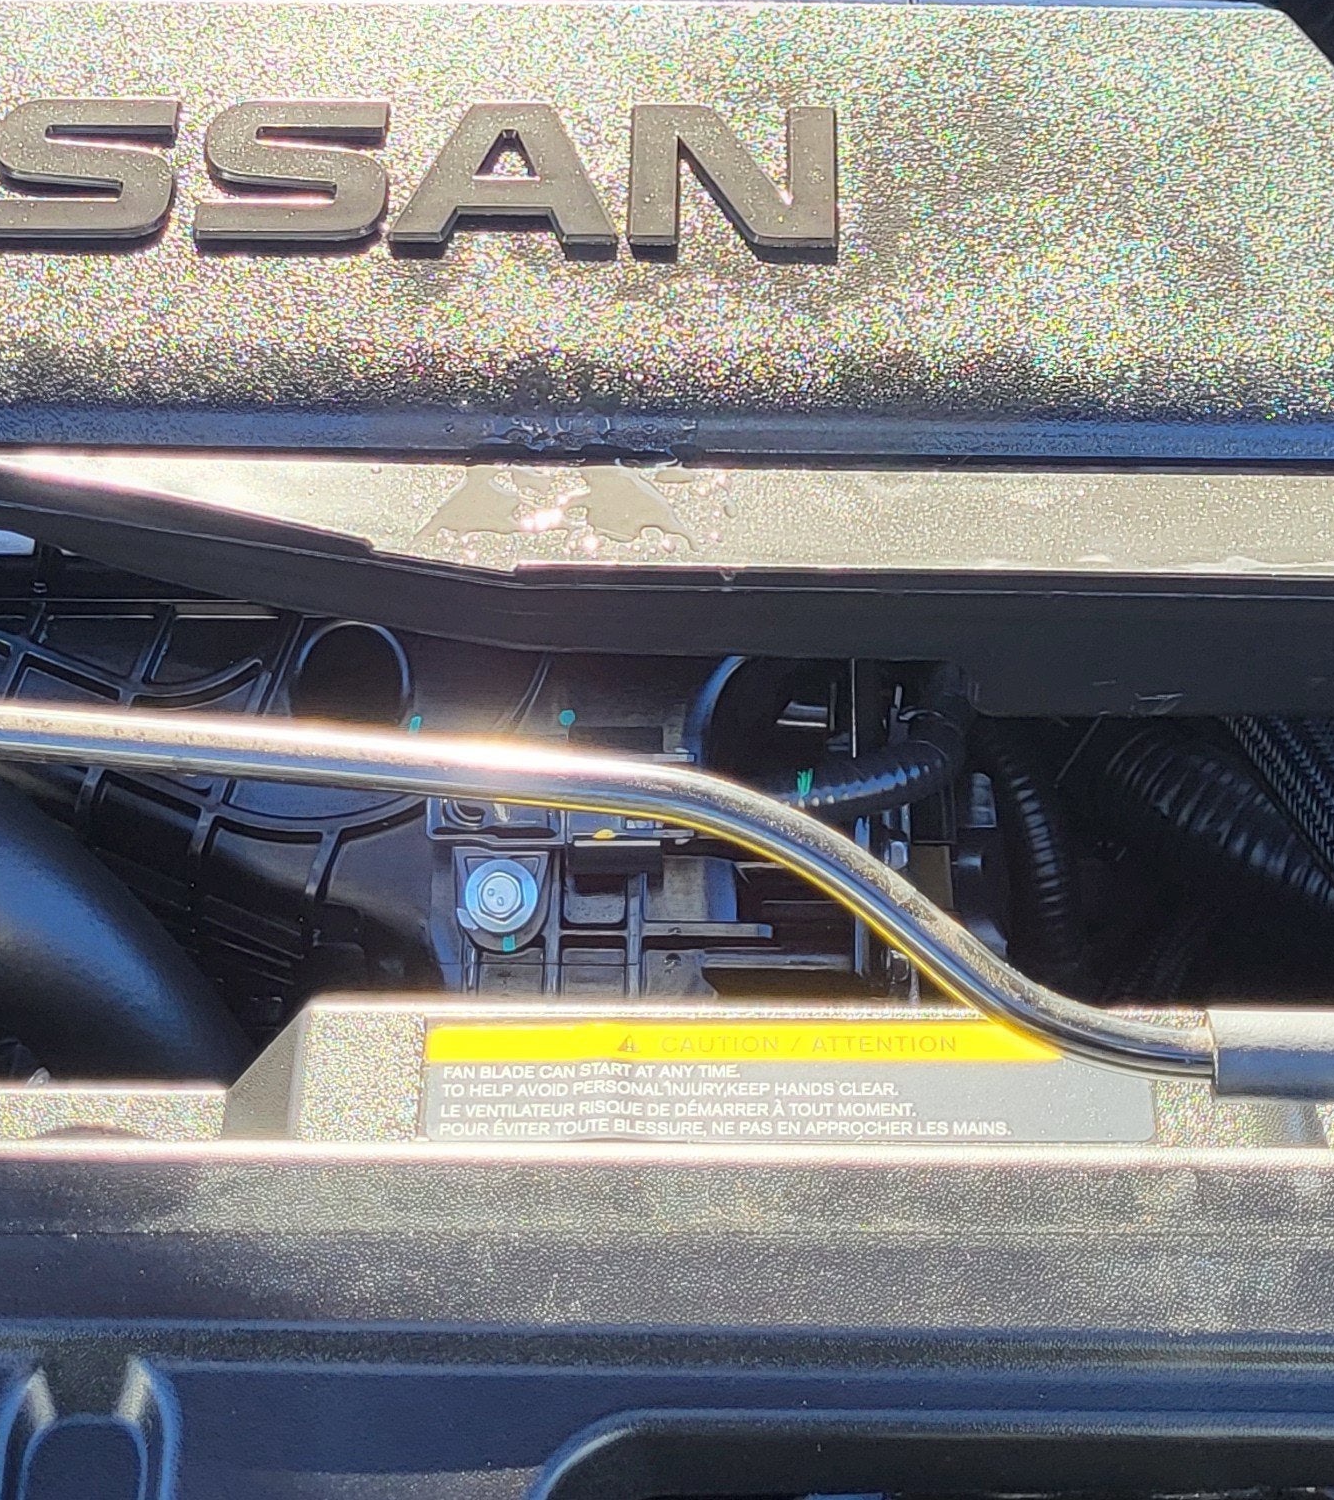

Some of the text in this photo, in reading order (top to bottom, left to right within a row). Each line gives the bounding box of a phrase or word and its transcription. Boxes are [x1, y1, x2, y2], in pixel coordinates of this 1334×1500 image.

[661, 1034, 780, 1053] CAUTION
[811, 1034, 958, 1053] ATTENTION
[442, 1061, 741, 1079] FAN BLADE CAN START AT ANY TIME.
[442, 1083, 464, 1097] TO
[469, 1083, 514, 1097] HELP
[517, 1083, 568, 1097] AVOID
[572, 1079, 663, 1097] PERSONAL
[774, 1082, 835, 1096] HANDS
[839, 1082, 899, 1096] CLEAR.
[440, 1098, 917, 1118] LE VENTILATEUR RISQUE DE DÉMARRER À TOUT MOMENT.
[439, 1118, 1013, 1137] POUR ÉVITER TOUTE BLESSURE, NE PAS EN APPROCHER LES MAINS.
